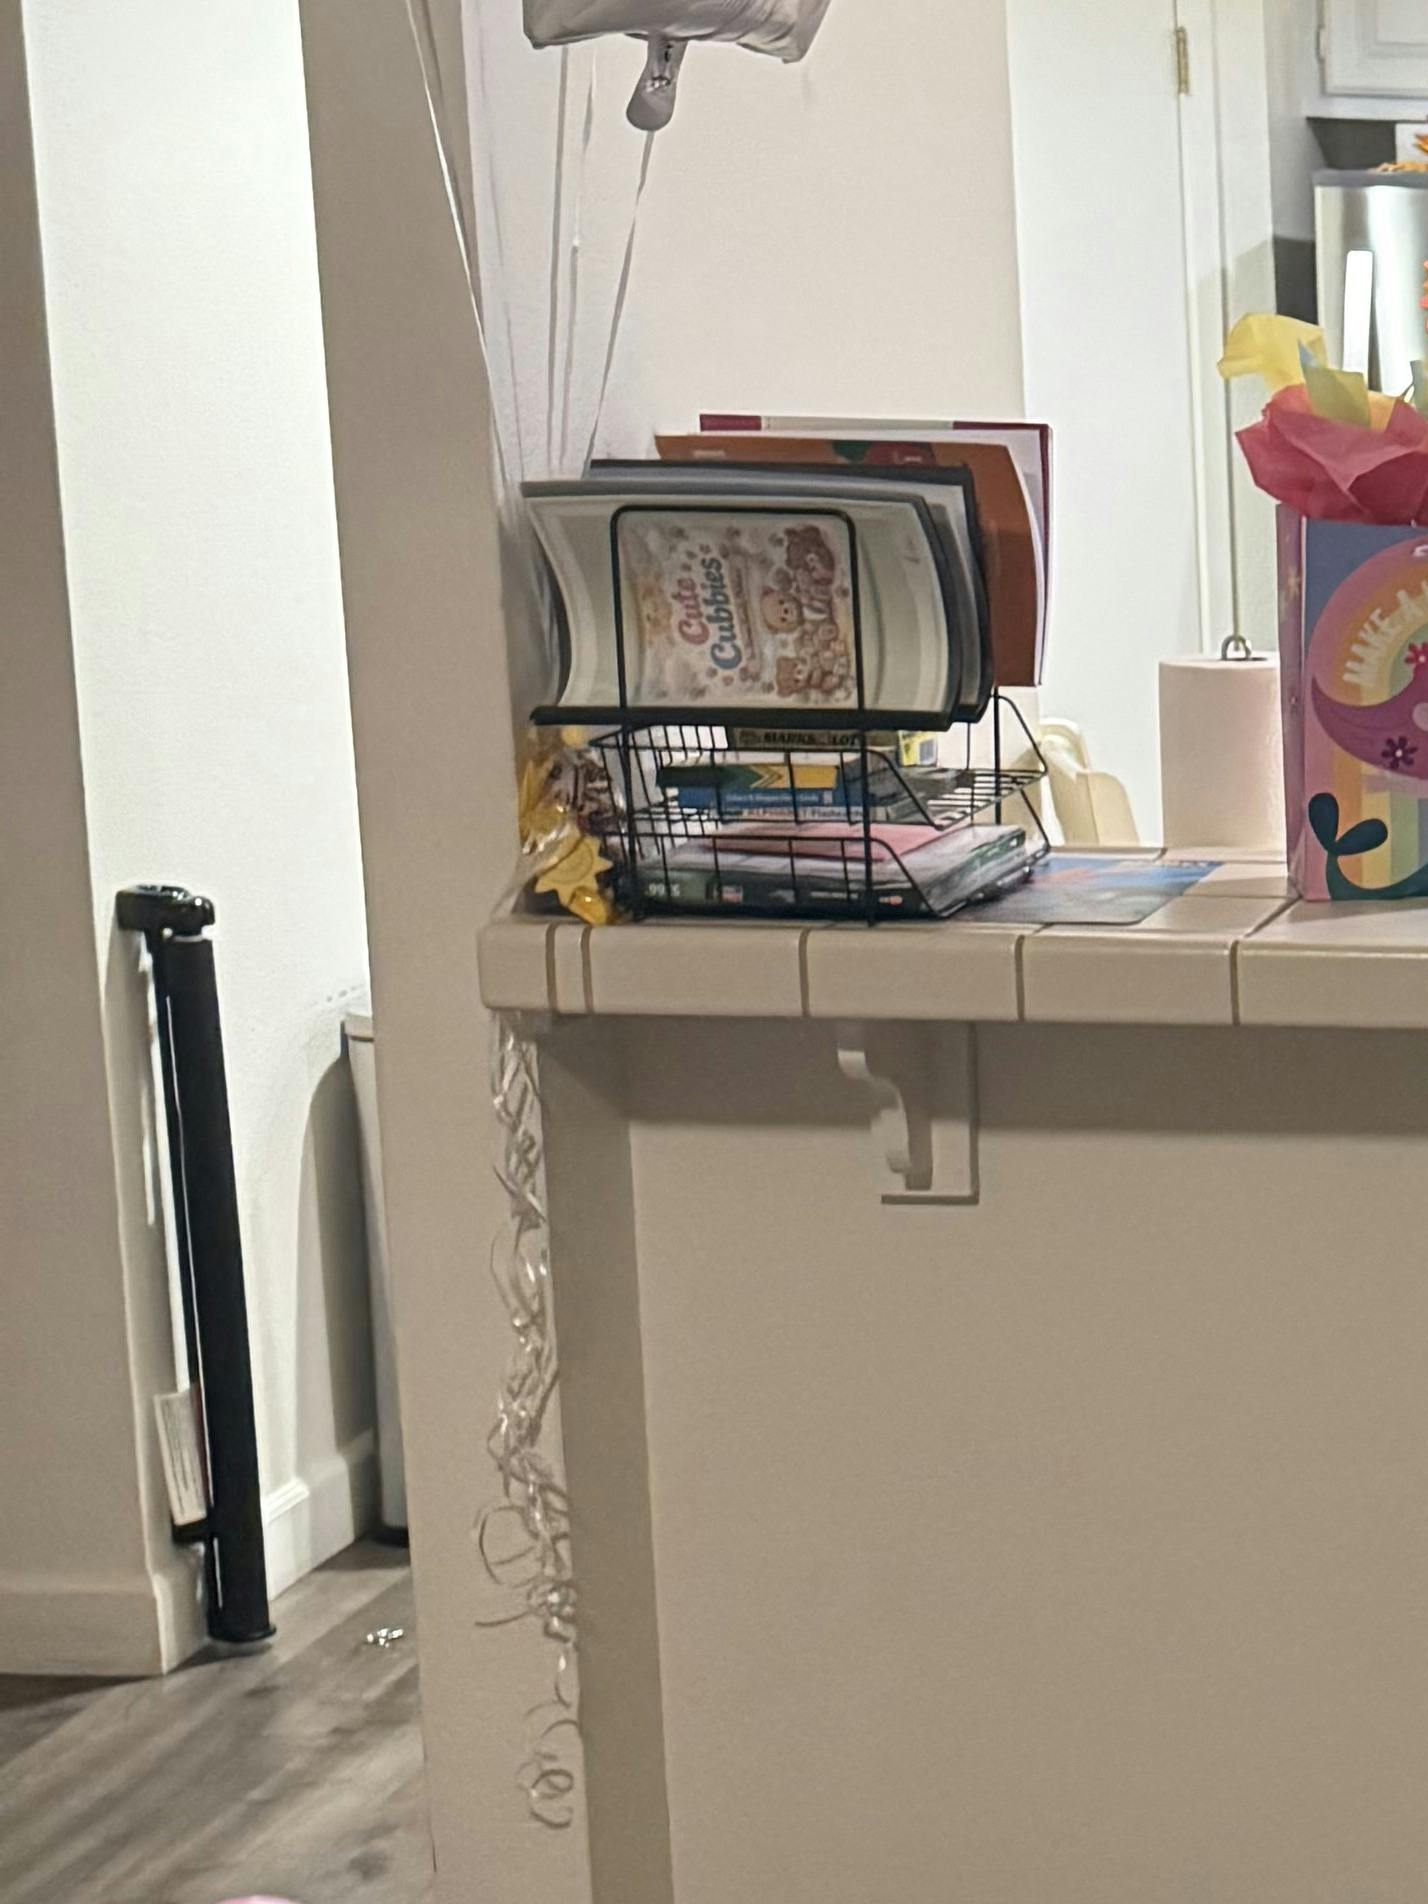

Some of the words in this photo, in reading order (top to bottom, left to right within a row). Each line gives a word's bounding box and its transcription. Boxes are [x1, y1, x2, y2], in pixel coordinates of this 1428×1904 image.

[671, 577, 710, 645] Cute
[702, 557, 743, 670] Cubbies
[1342, 607, 1395, 687] MAKE
[1395, 589, 1424, 619] A
